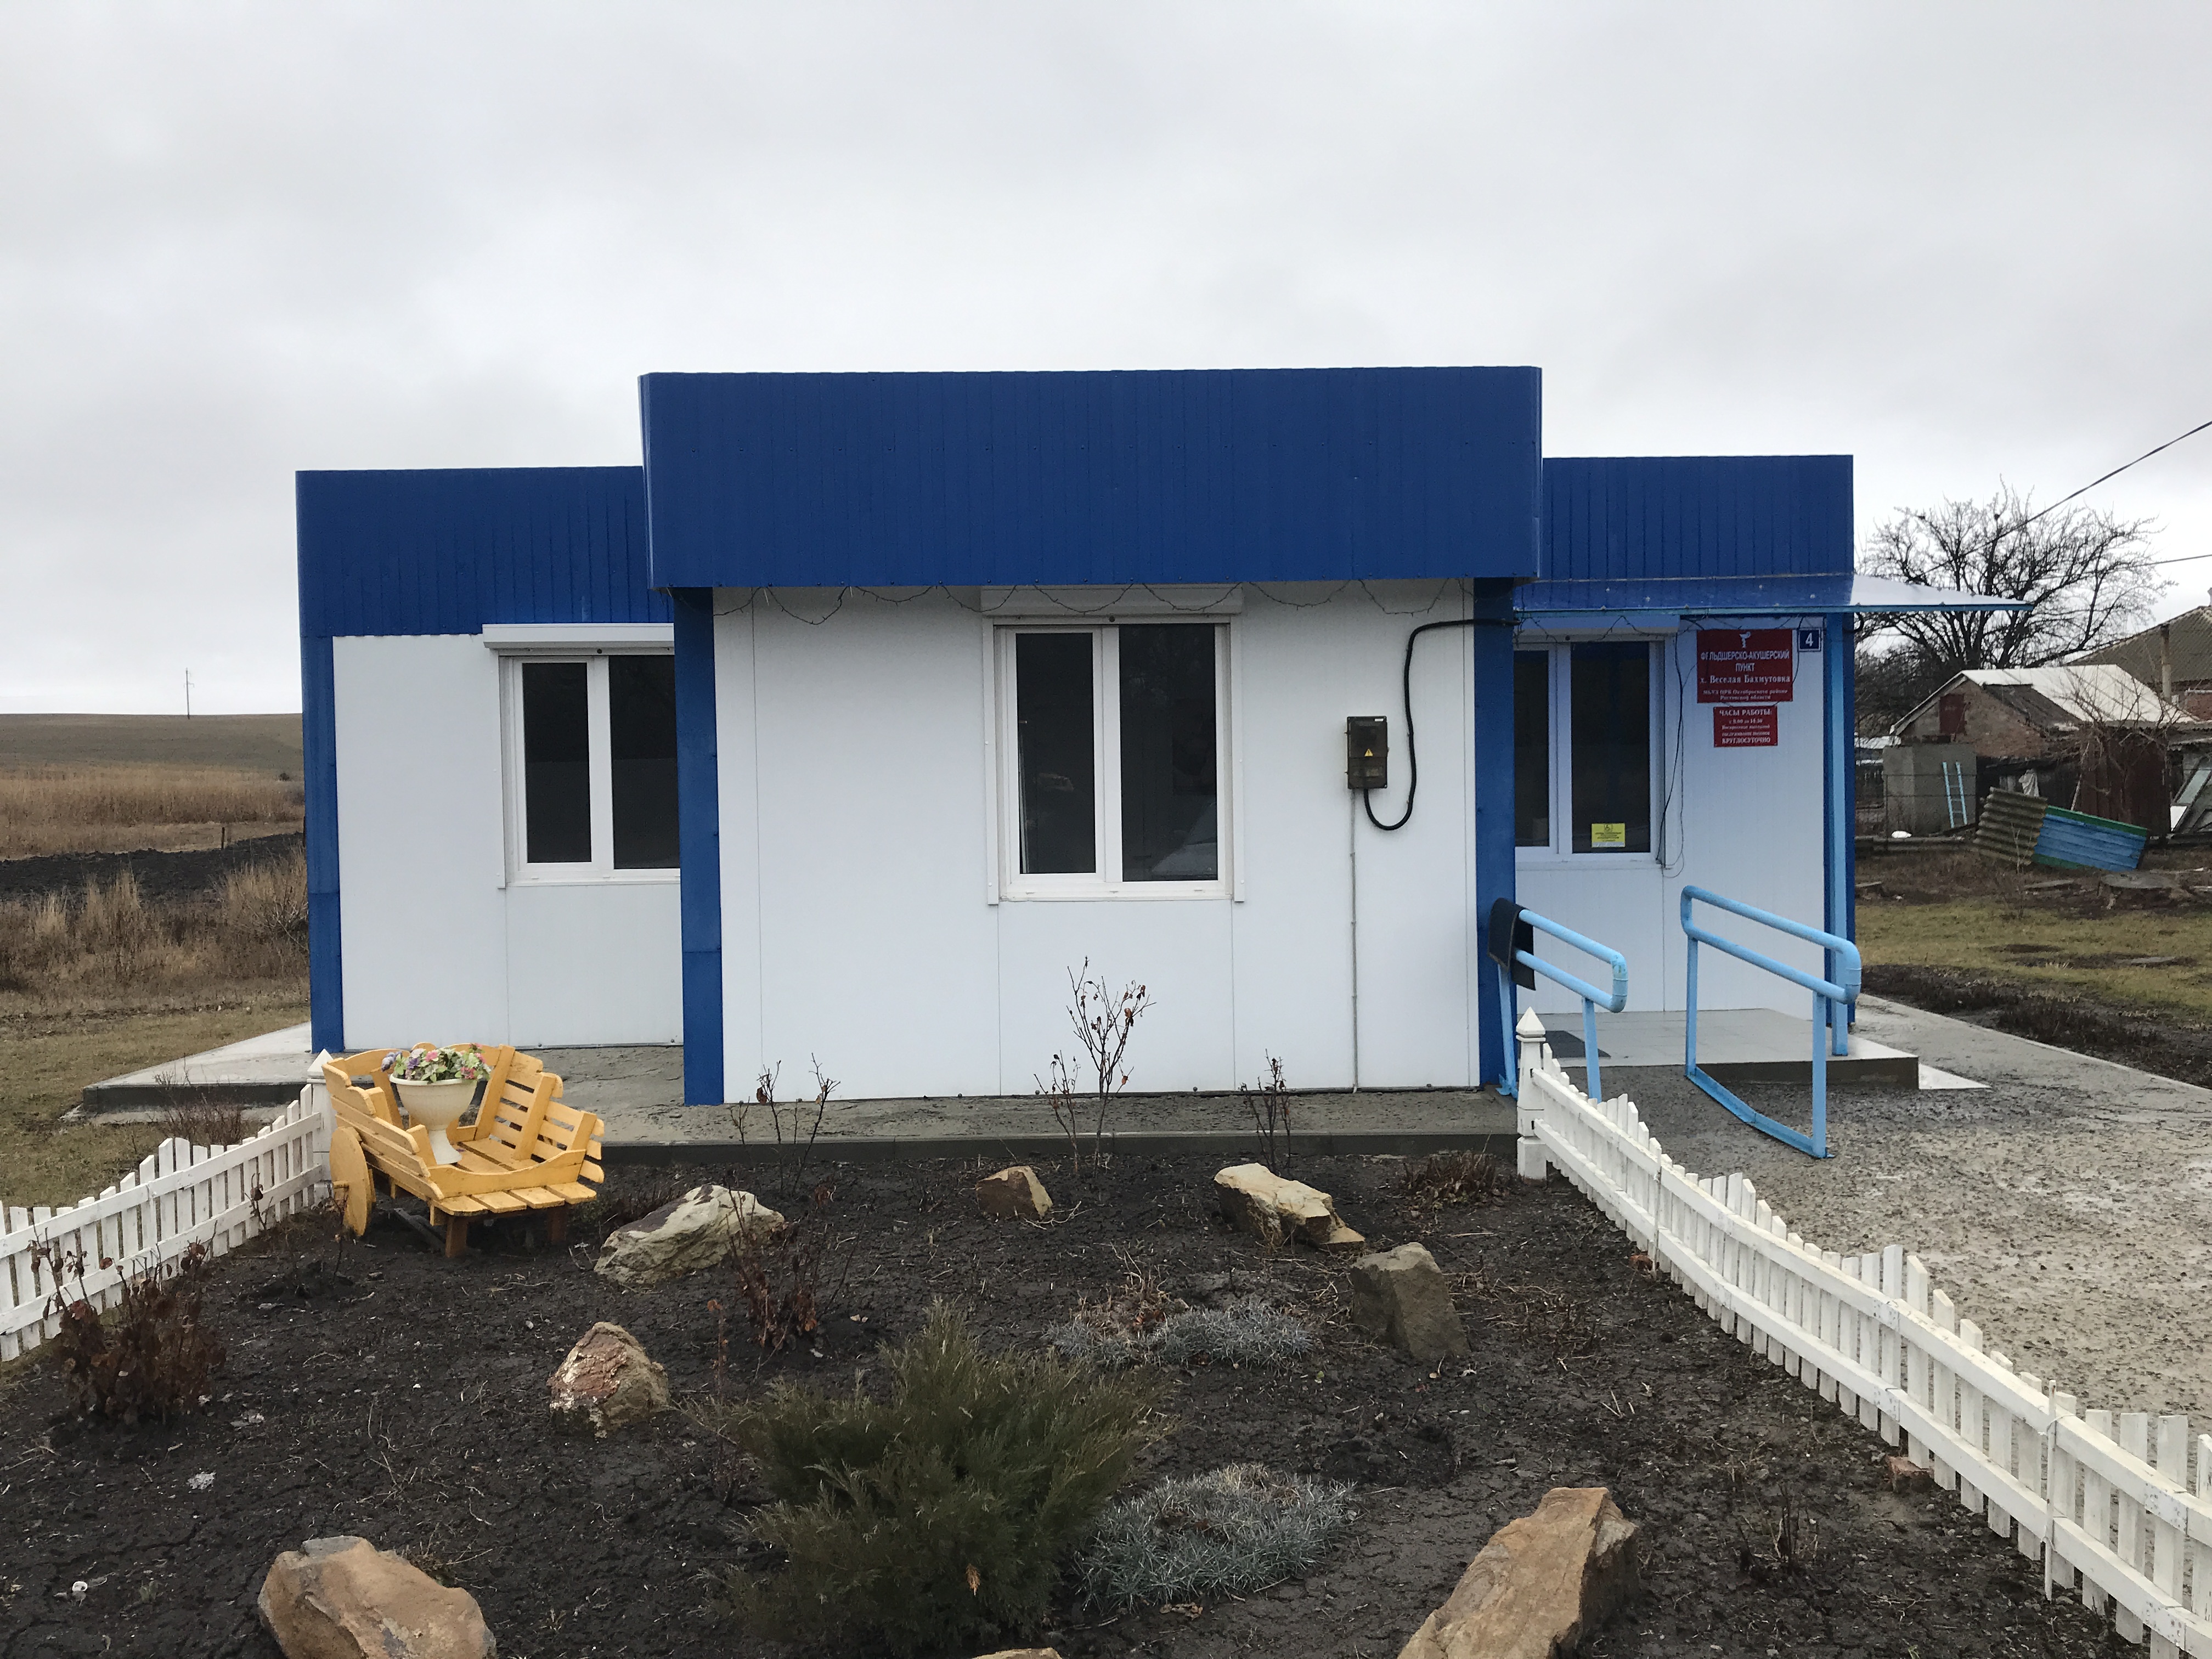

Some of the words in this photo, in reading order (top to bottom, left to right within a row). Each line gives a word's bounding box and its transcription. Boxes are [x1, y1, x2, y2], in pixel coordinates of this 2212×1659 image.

[1805, 633, 1814, 647] 4
[1735, 663, 1755, 672] ПУНКТ
[1709, 675, 1741, 684] Веселая
[1744, 674, 1791, 685] Бахмутовка
